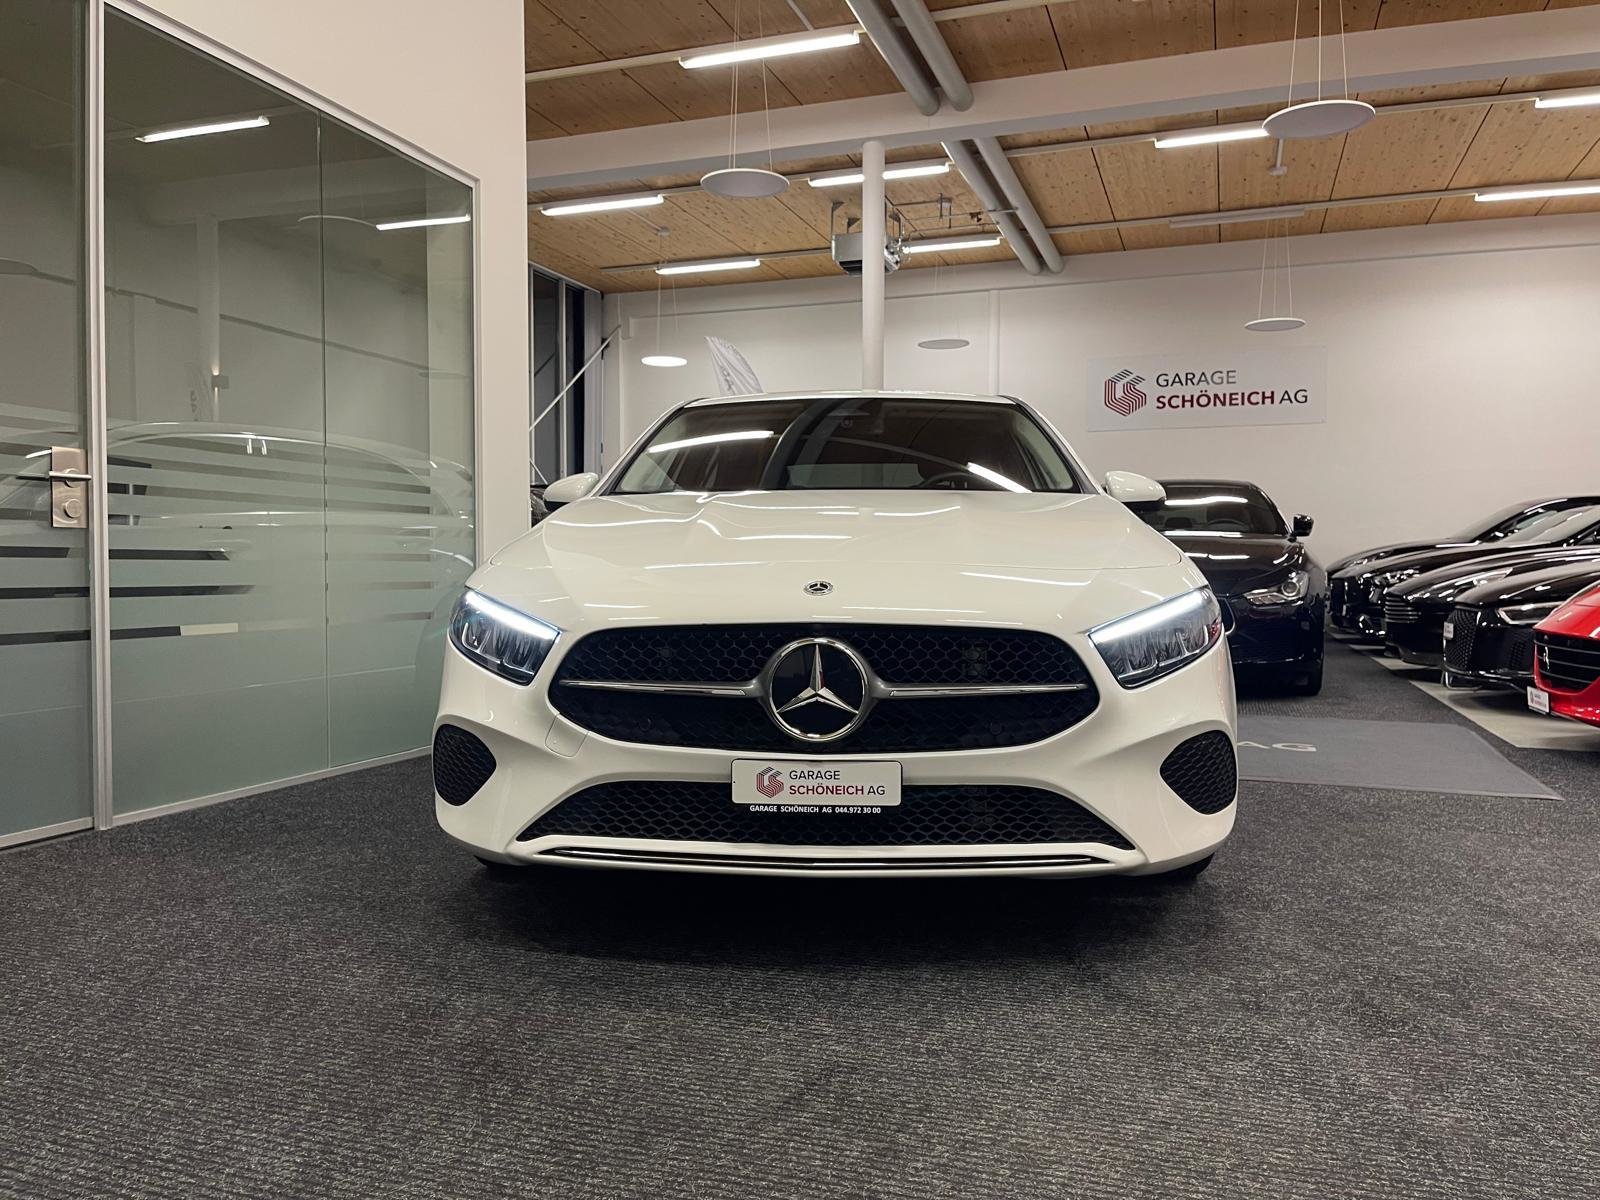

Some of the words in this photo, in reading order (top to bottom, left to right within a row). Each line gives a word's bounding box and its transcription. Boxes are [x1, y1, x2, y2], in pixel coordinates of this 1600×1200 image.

[1155, 370, 1237, 388] GARAGE
[1155, 390, 1275, 410] SCHÖNEICH
[1279, 389, 1308, 405] AG
[789, 770, 841, 780] GARAGE
[789, 783, 864, 796] SCHÖNEICH
[867, 785, 886, 796] AG
[780, 805, 819, 813] SCHÖNEICH
